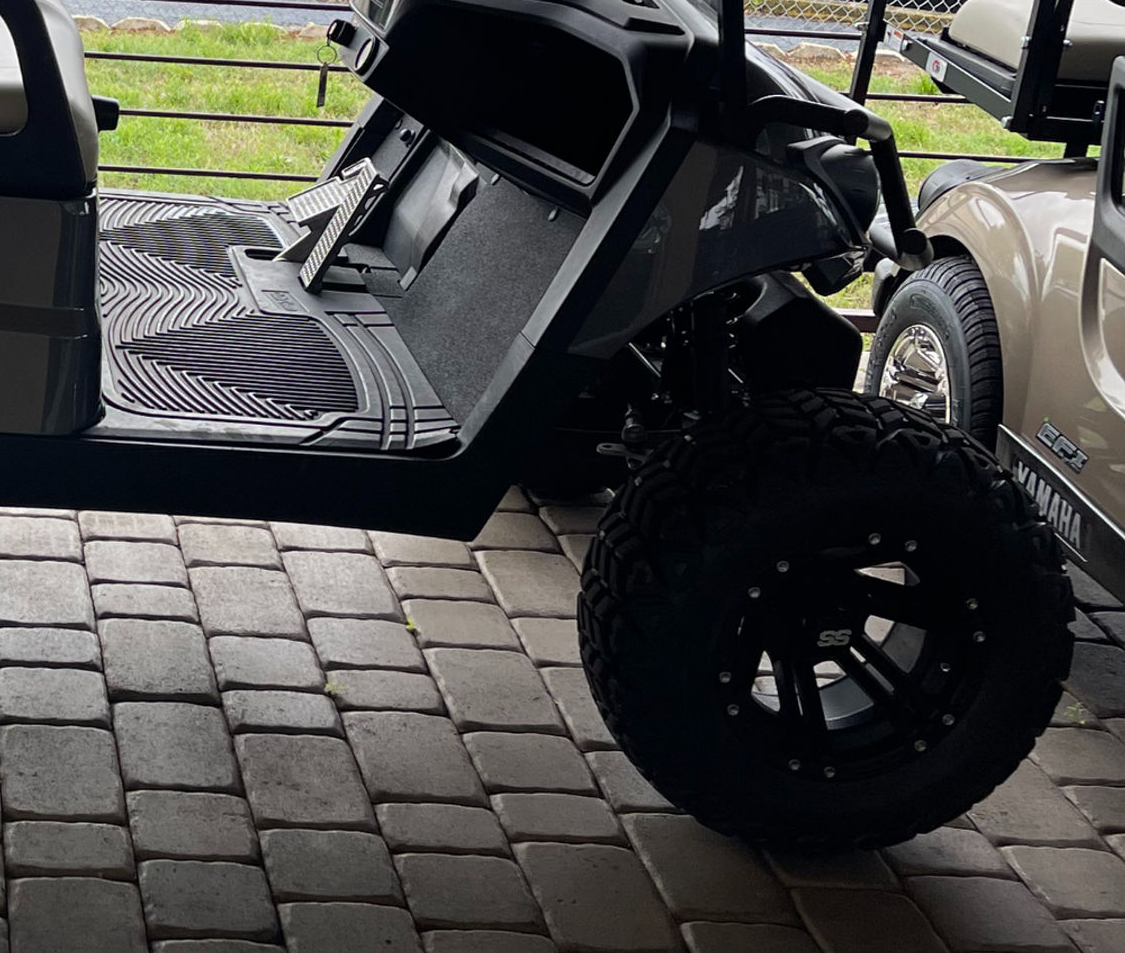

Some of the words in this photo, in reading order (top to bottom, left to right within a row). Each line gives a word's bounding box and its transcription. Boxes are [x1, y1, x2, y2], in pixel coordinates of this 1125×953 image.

[1036, 422, 1088, 473] EFI
[1017, 460, 1082, 549] YAMAHA
[816, 629, 852, 647] SS
